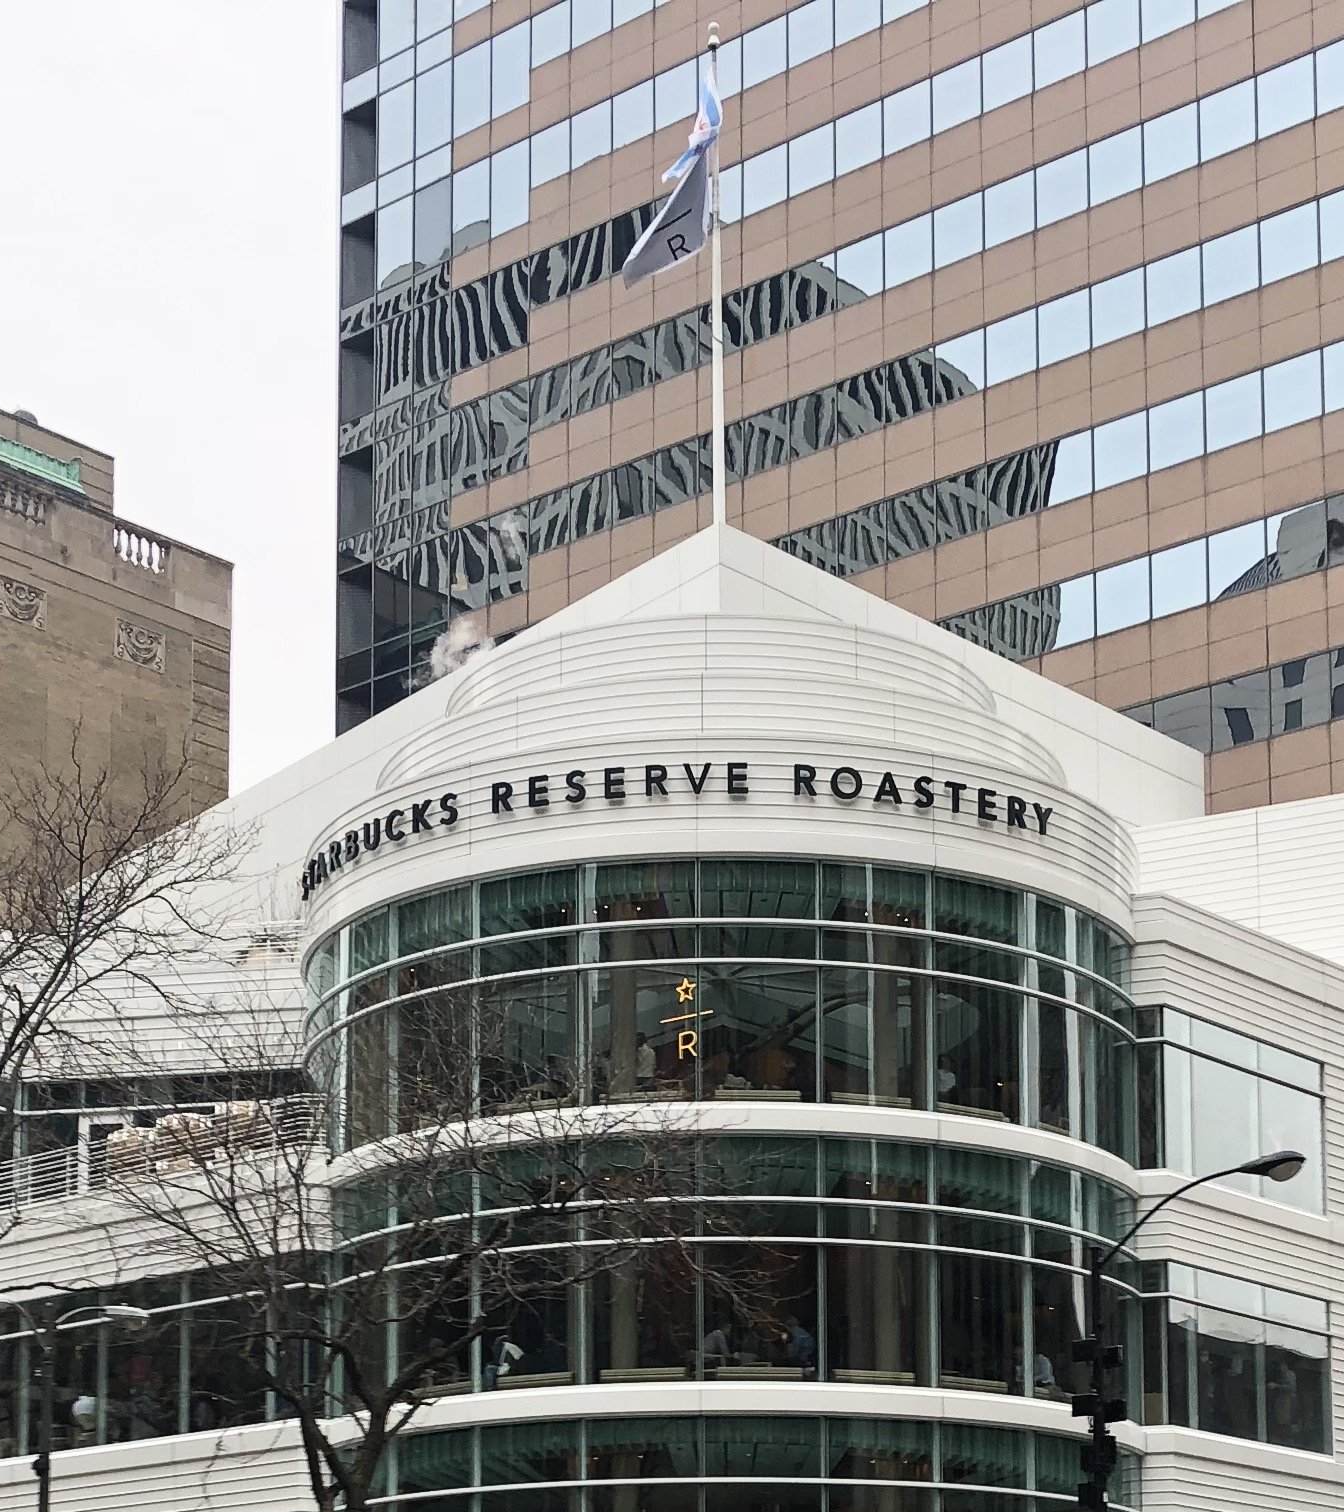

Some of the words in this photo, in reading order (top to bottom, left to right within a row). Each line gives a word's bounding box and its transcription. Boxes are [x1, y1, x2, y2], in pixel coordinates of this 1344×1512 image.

[667, 233, 691, 260] R
[301, 792, 458, 901] STARBUCKS
[491, 762, 749, 814] RESERVE
[793, 763, 1053, 835] ROASTERY
[678, 1030, 698, 1059] R
